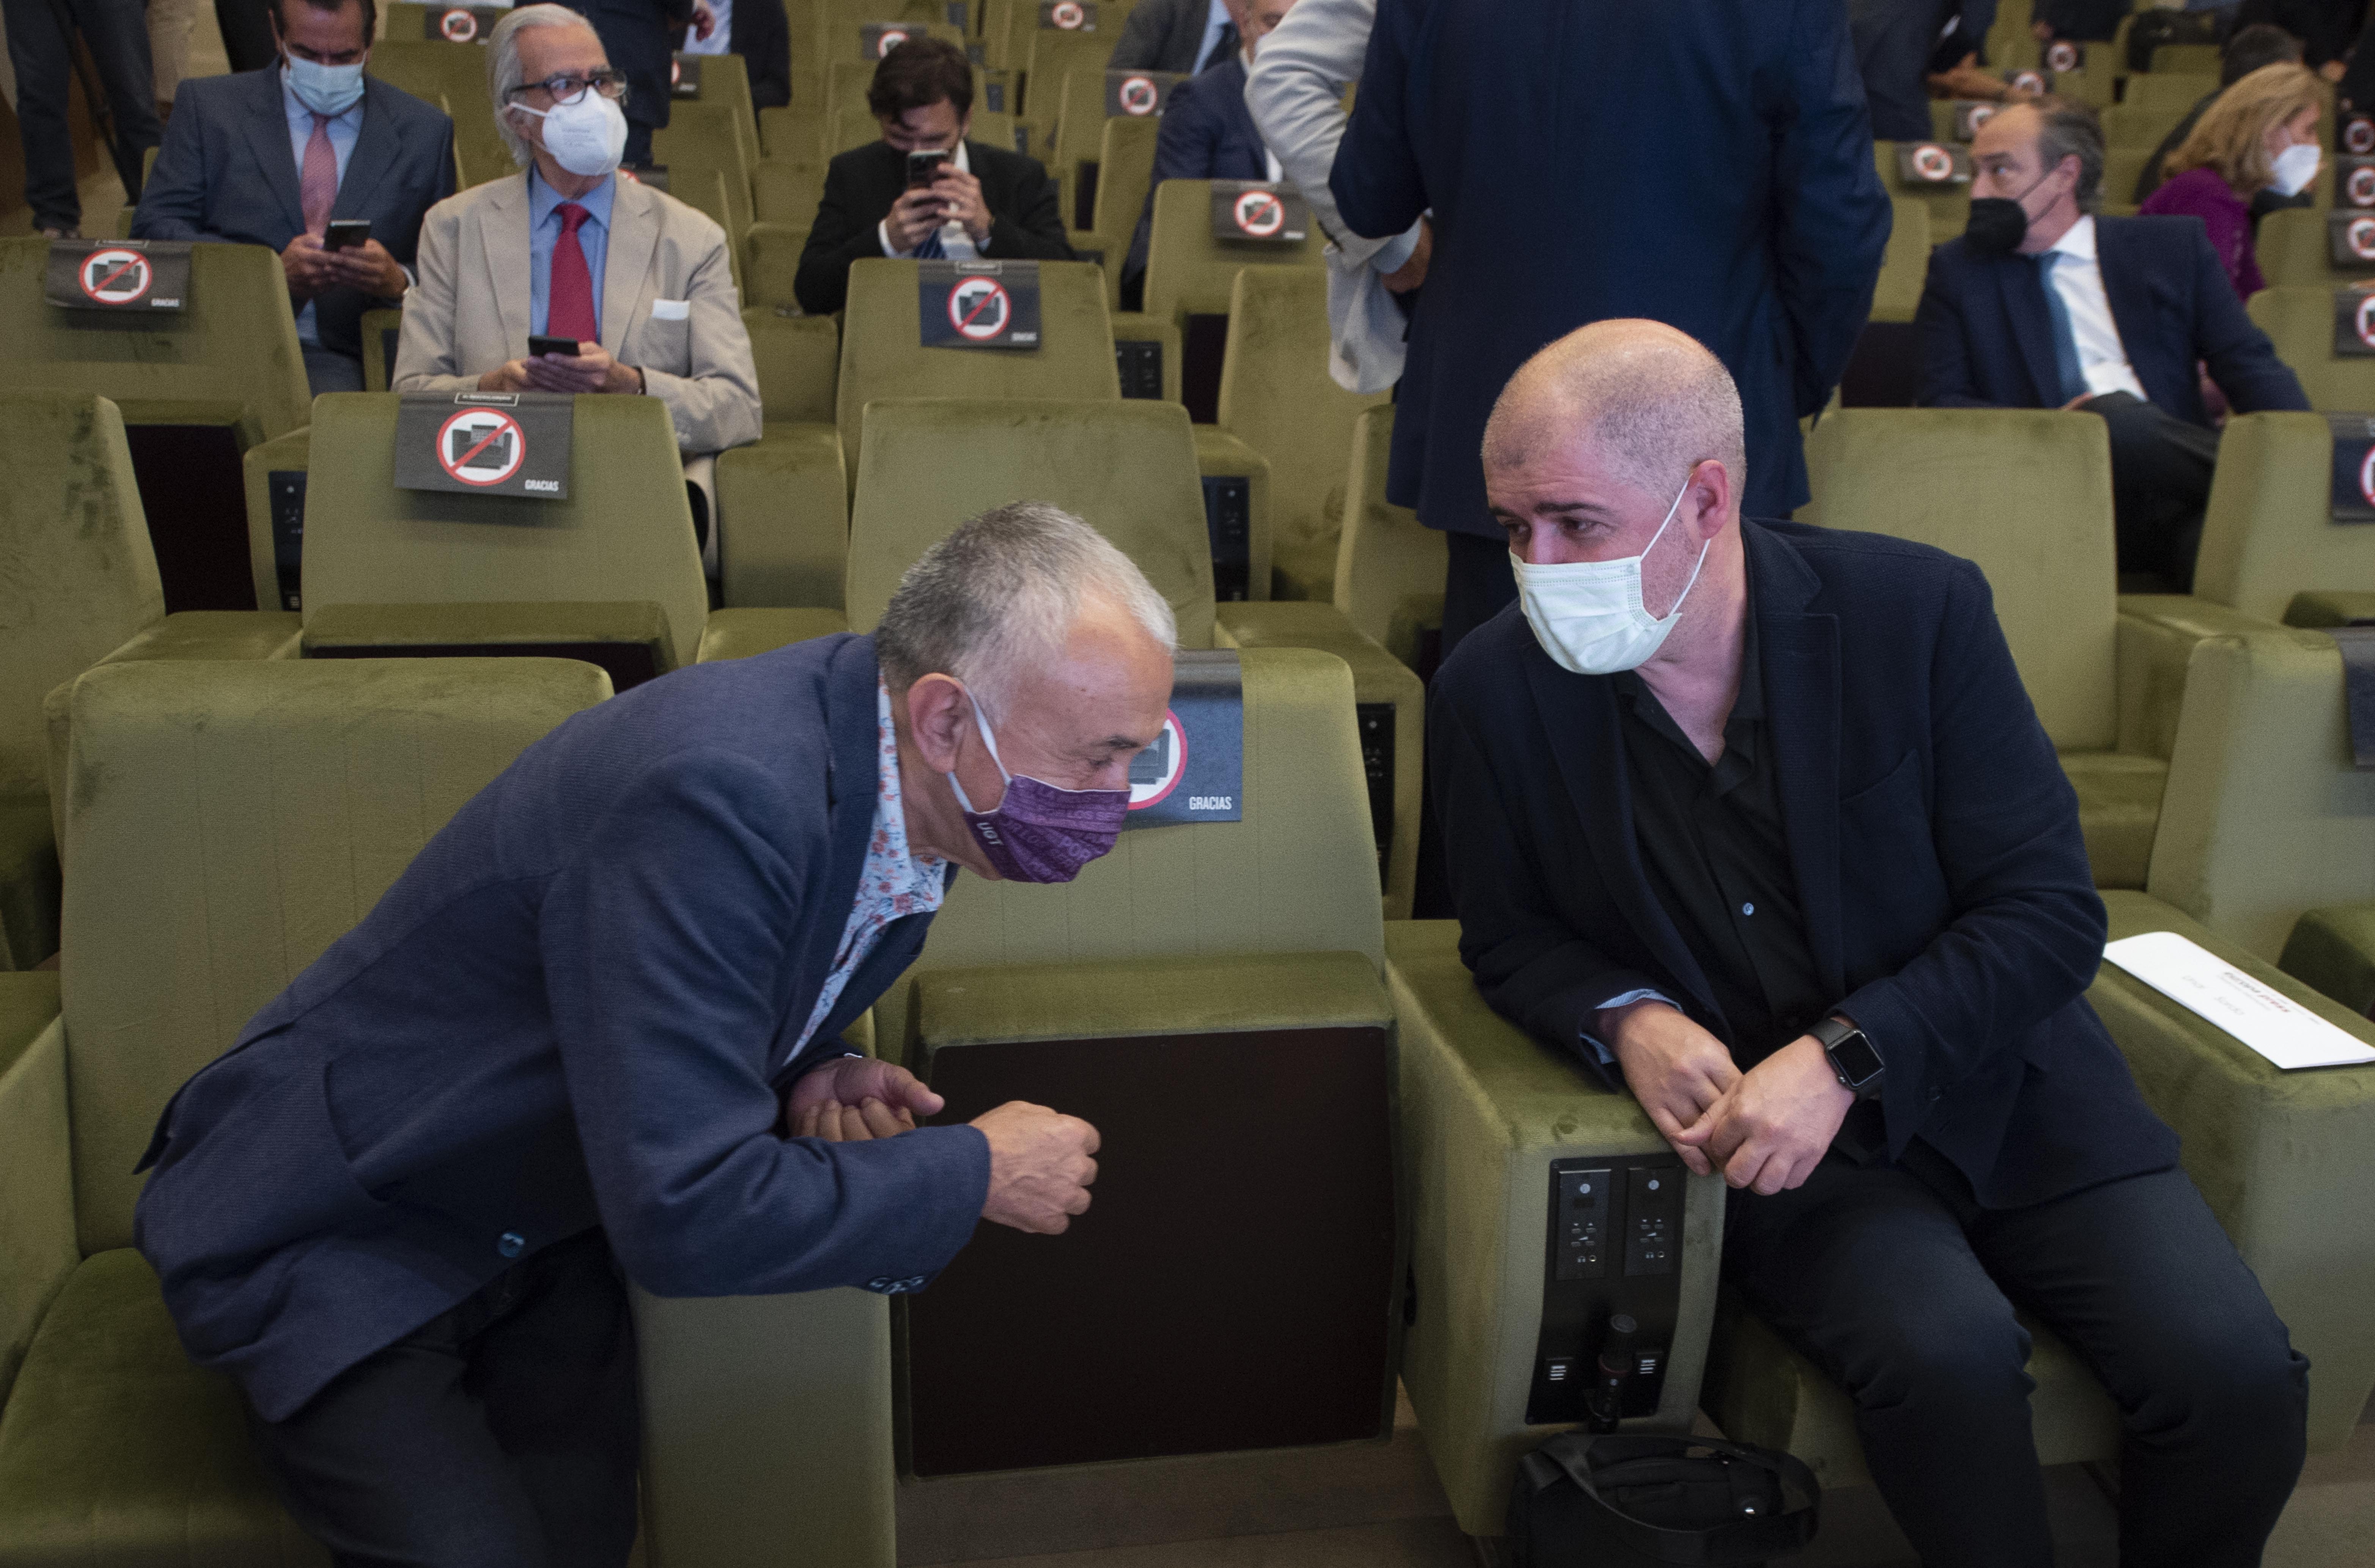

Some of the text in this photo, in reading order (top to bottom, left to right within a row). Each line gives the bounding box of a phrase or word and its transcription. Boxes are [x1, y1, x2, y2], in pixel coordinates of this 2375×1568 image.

[525, 479, 559, 492] GRACIAS
[1189, 796, 1232, 810] GRACIAS
[977, 822, 1004, 845] UGT
